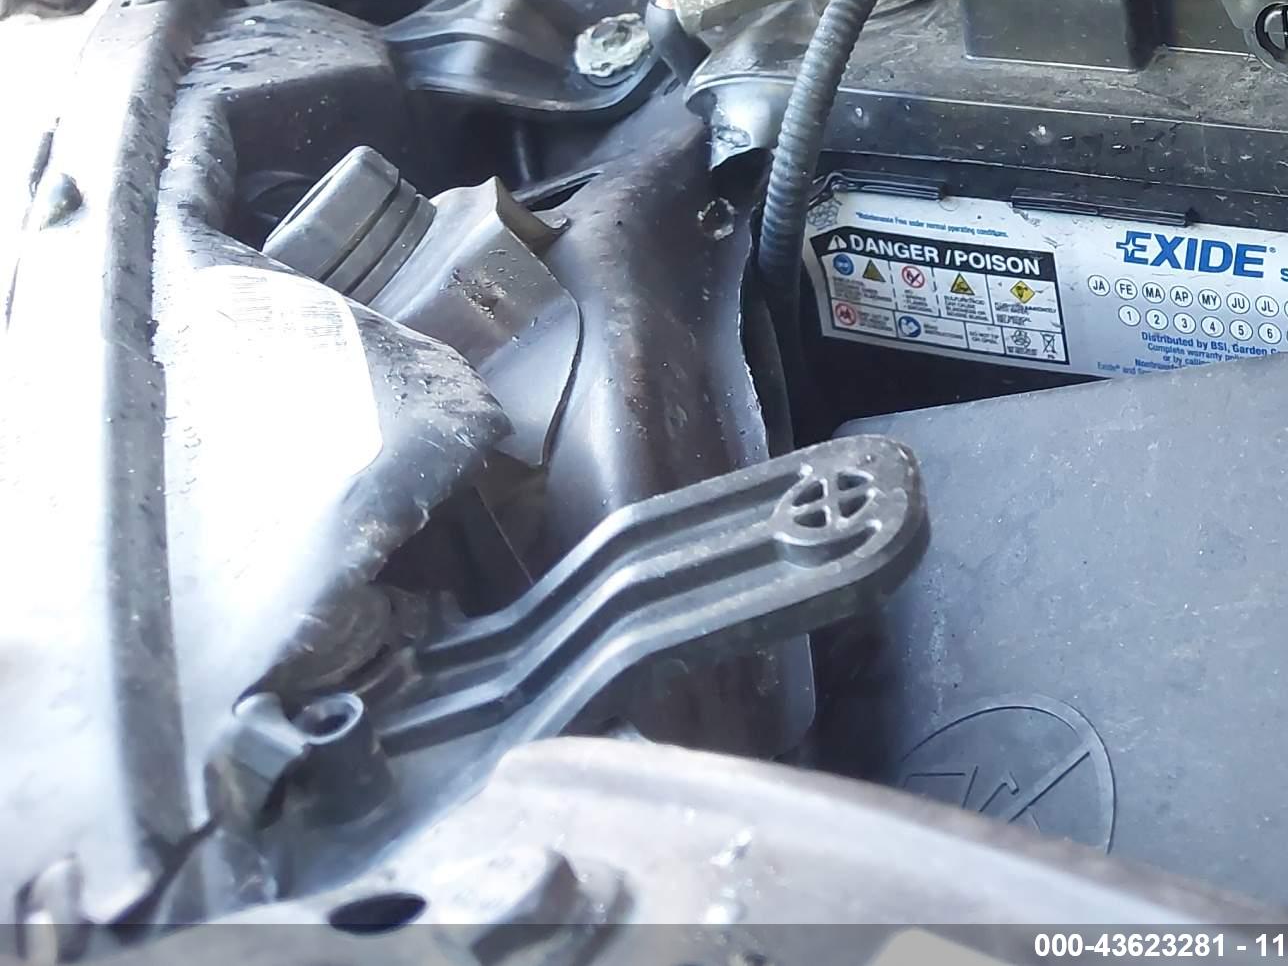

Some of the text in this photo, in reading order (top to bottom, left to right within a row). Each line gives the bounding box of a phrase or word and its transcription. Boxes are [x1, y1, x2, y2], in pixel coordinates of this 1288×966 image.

[850, 234, 939, 263] DANGER
[1119, 284, 1133, 295] FE
[1145, 287, 1162, 299] MA
[1174, 290, 1189, 302] AP
[1201, 294, 1217, 306] MY
[1231, 298, 1245, 310] JU
[1261, 300, 1274, 313] JL
[1141, 331, 1195, 349] Distributed
[1197, 340, 1208, 352] by
[1148, 343, 1185, 357] Complete
[1186, 349, 1223, 362] warranty
